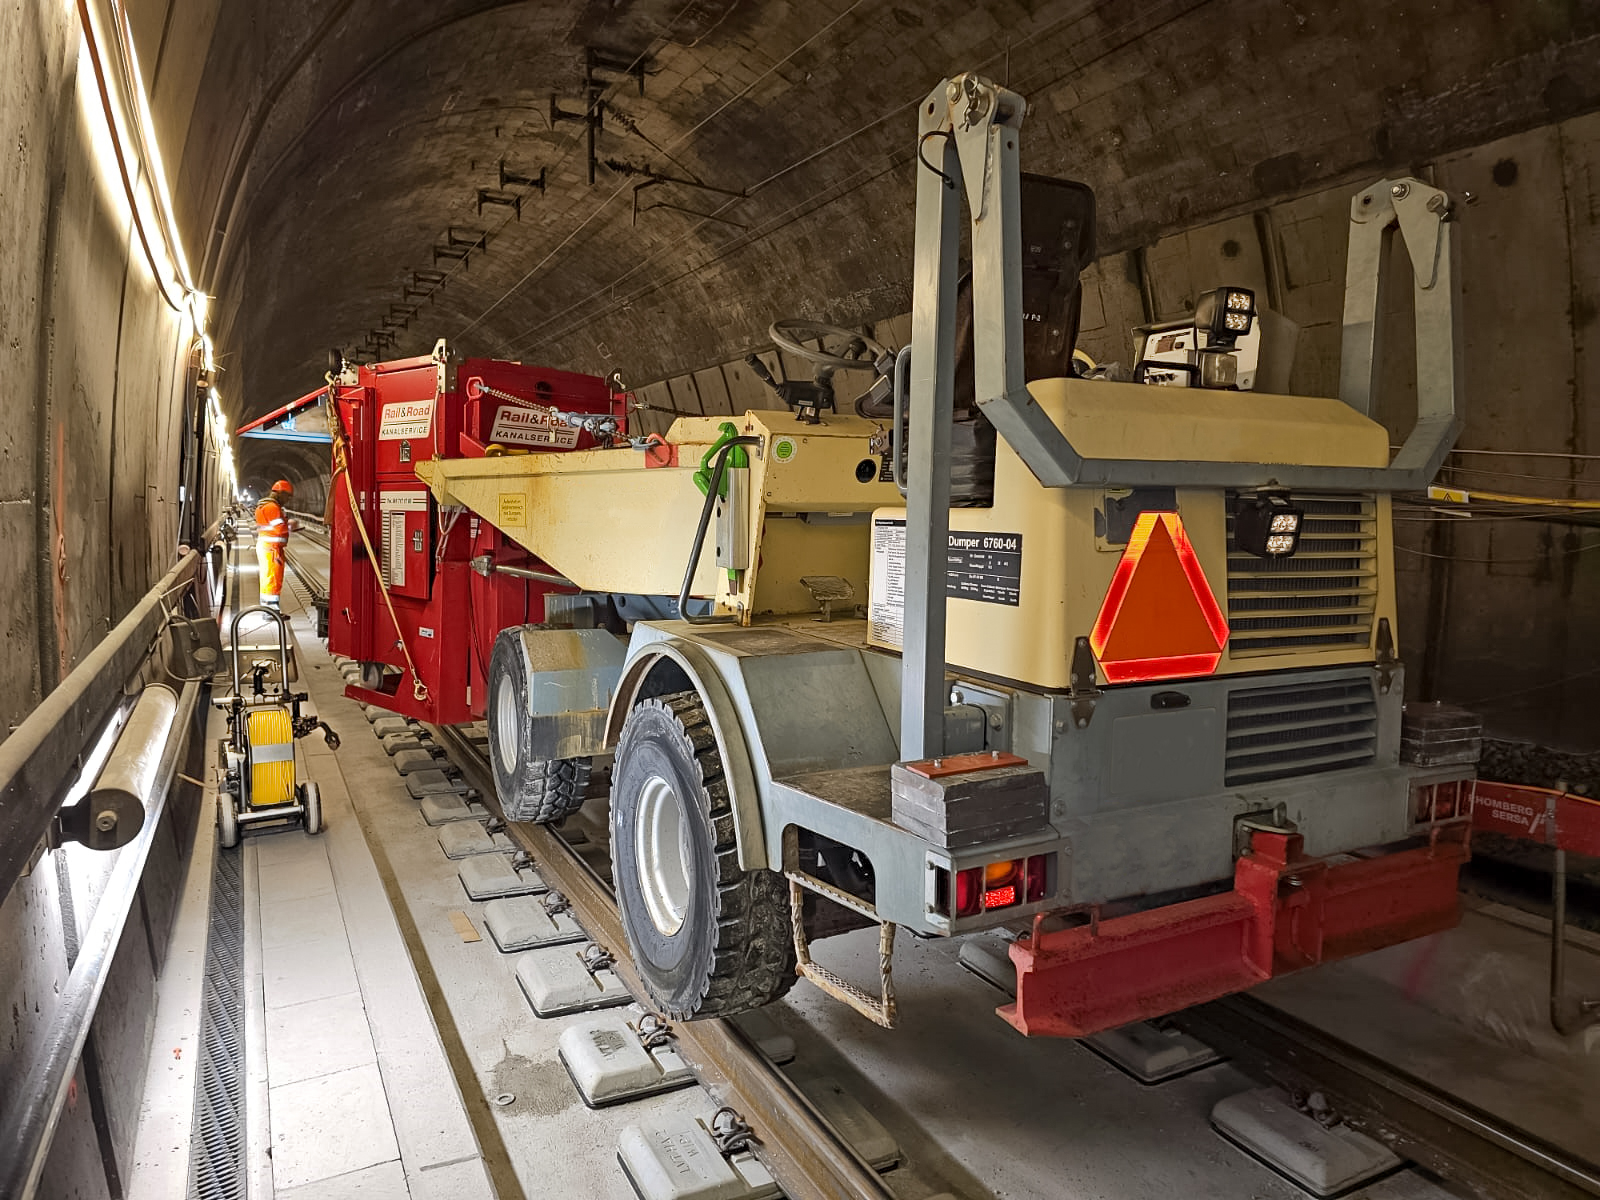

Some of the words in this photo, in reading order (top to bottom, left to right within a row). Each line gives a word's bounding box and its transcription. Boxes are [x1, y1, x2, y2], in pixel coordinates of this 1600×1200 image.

[385, 404, 430, 419] Rail&Road
[501, 410, 568, 428] Rail&Roa
[382, 426, 428, 436] KANALSERVICE
[495, 430, 574, 445] KANALSERICE
[948, 535, 980, 550] Dumper
[983, 537, 1017, 550] 6760-04
[1491, 809, 1530, 826] SERSA
